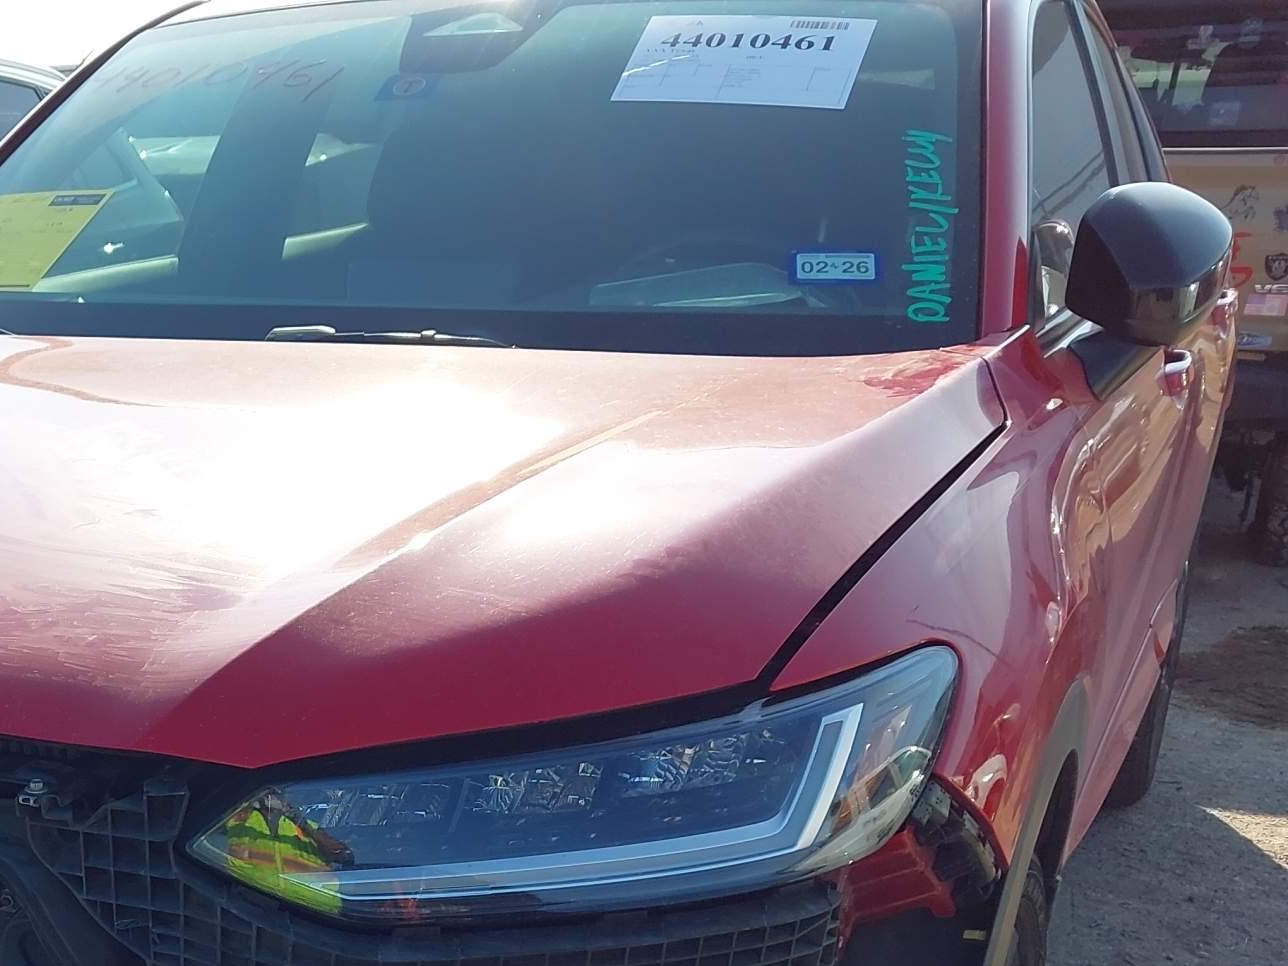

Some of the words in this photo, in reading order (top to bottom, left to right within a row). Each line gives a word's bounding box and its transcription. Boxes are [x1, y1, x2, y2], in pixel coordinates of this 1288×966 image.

[661, 32, 836, 51] 44010461
[800, 260, 830, 274] 02
[841, 260, 870, 274] 26
